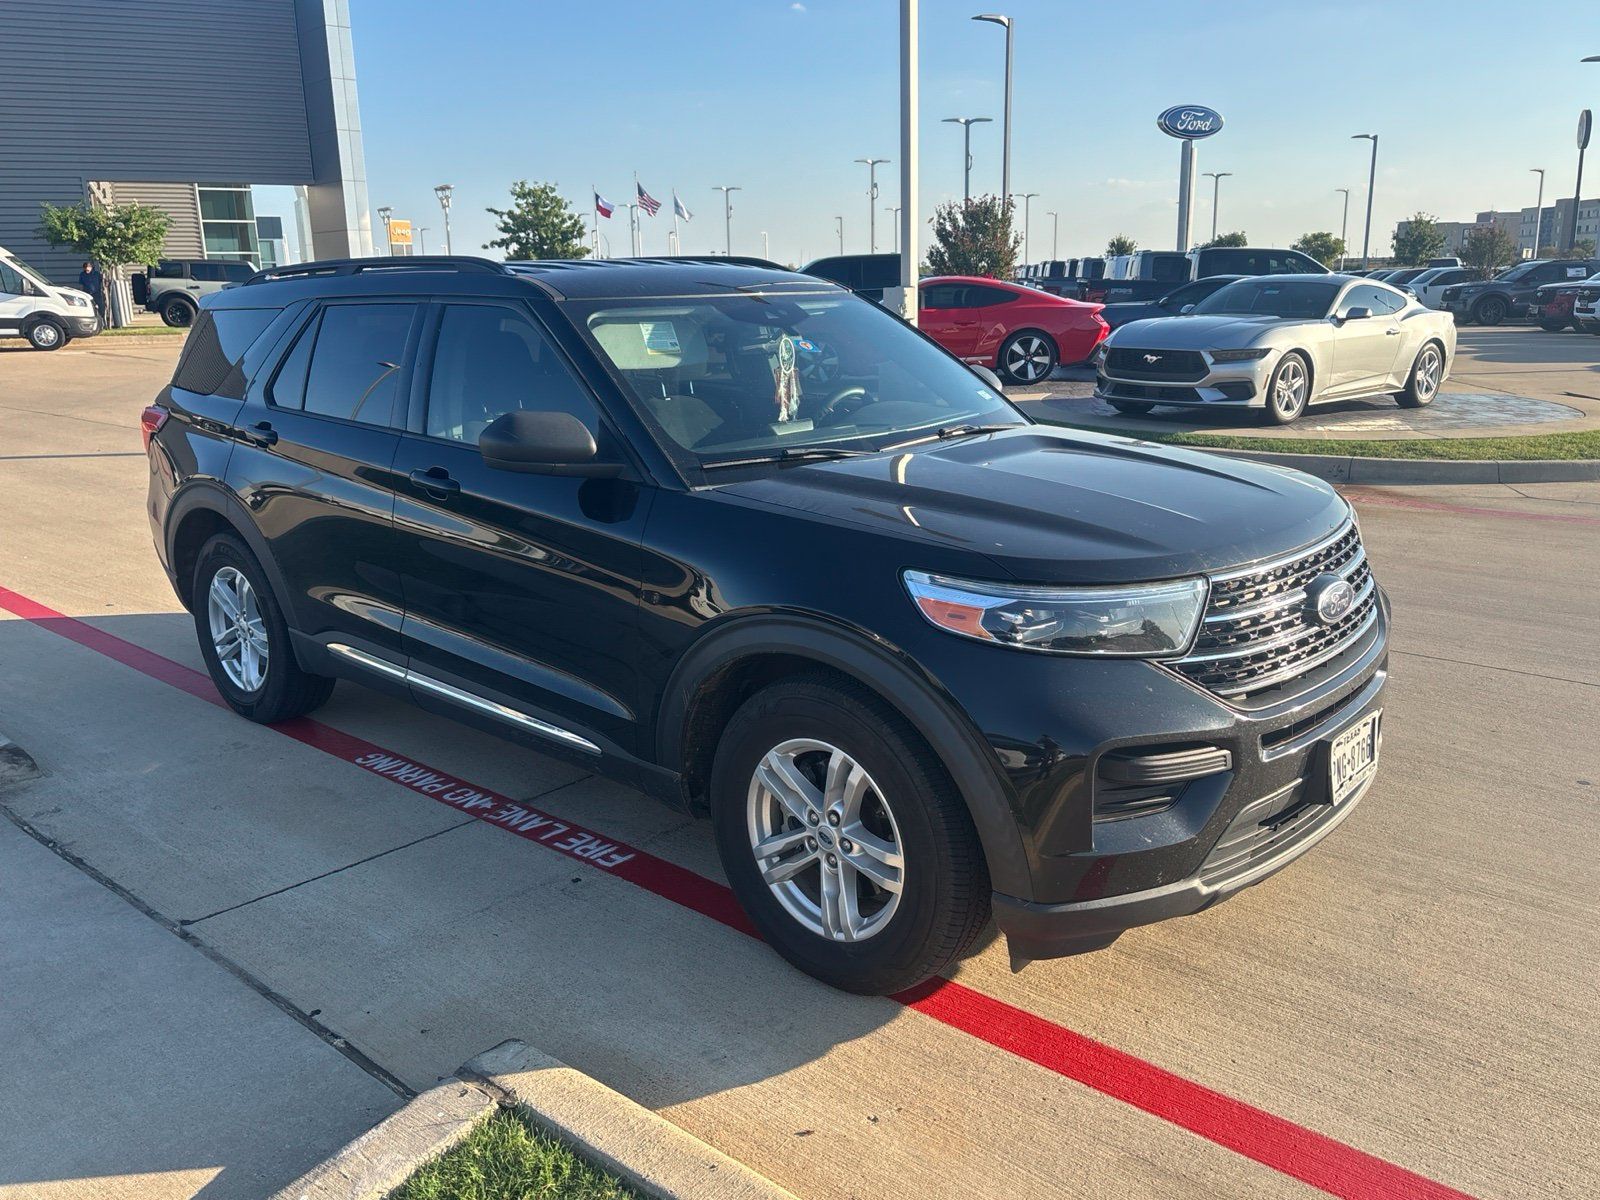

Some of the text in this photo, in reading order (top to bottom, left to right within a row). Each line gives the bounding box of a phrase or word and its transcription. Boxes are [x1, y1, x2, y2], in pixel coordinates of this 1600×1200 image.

[1177, 110, 1213, 131] Ford
[392, 227, 411, 238] Jeep
[1343, 728, 1361, 747] TEXAS
[354, 752, 636, 867] FIRE LANE NO PARKING
